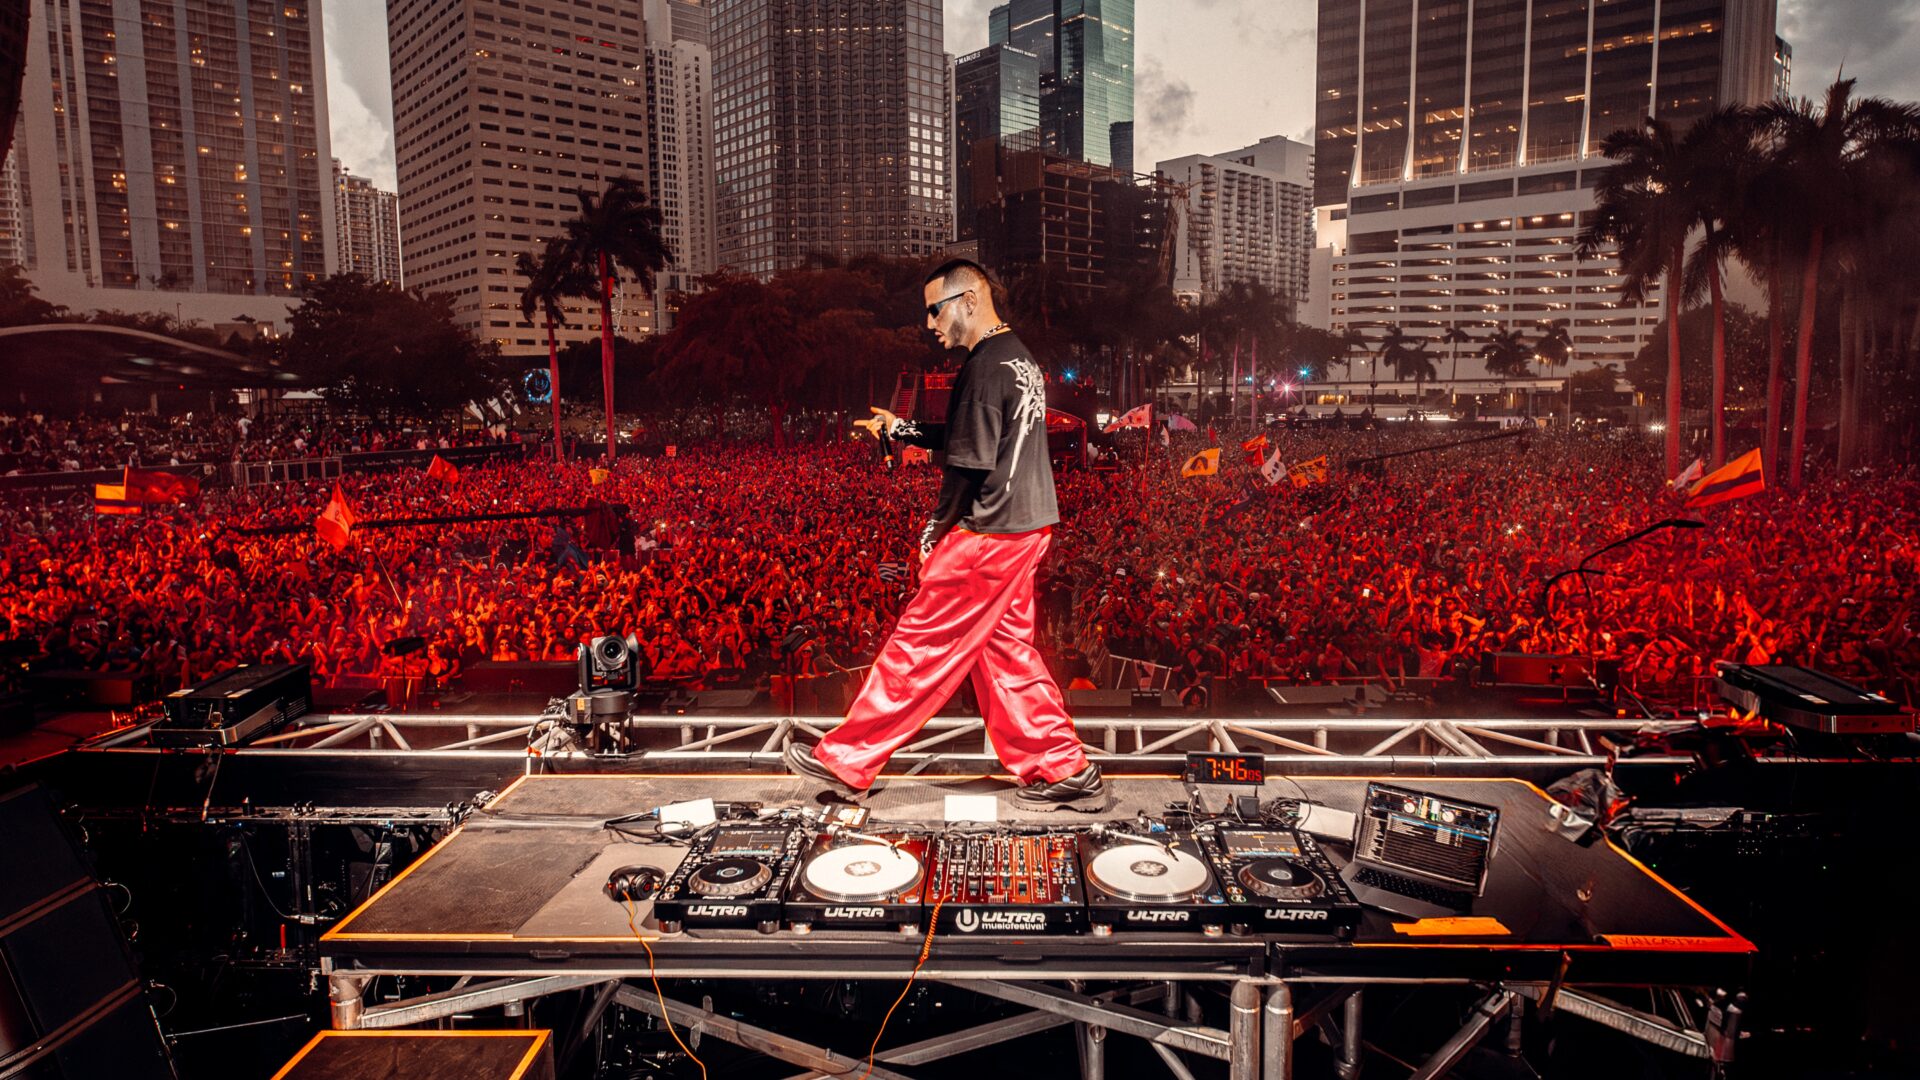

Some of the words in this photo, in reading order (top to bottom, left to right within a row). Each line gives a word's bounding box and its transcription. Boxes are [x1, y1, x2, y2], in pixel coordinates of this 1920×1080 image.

[1206, 758, 1247, 781] 7:46
[687, 904, 749, 917] ULTRA
[823, 907, 885, 918] ULTRA
[1126, 910, 1190, 922] ULTRA
[1264, 909, 1328, 921] ULTRA
[981, 911, 1046, 923] ULTRA
